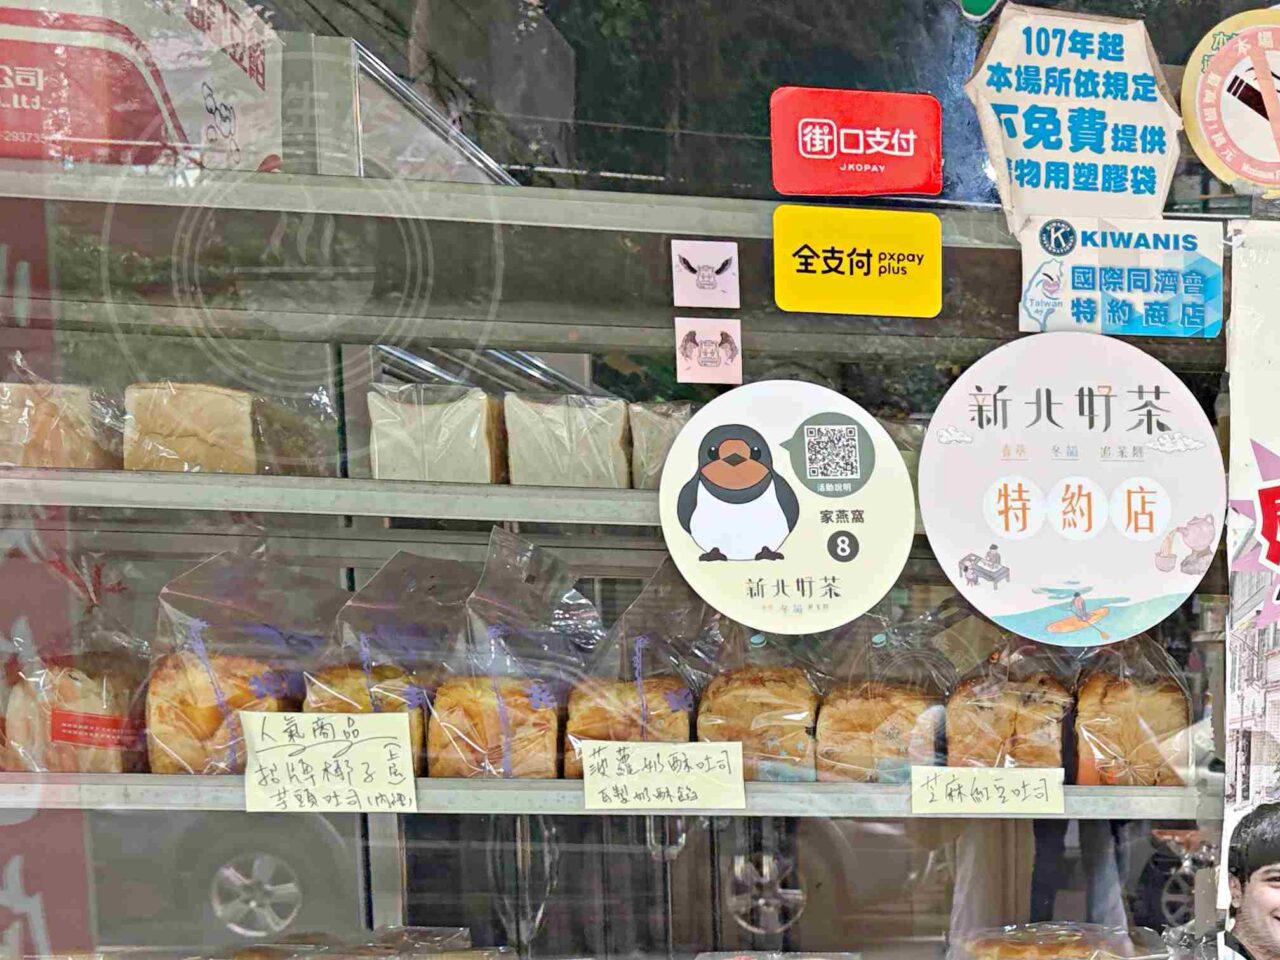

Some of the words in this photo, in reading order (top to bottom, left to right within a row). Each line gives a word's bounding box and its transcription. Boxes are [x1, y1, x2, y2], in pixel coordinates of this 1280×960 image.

[1022, 26, 1124, 62] 107年起
[986, 62, 1158, 102] 本場所依規定
[798, 118, 918, 159] 街口支付
[840, 163, 885, 172] JKOPAY
[1006, 157, 1157, 195] 物用塑膠袋
[1081, 230, 1198, 251] KIWANIS
[792, 243, 873, 276] 全支付
[878, 251, 924, 265] pxpay
[878, 263, 907, 276] plus
[1071, 266, 1204, 295] 國際同濟會
[1071, 298, 1205, 328] 特約商店
[820, 509, 864, 524] 家燕窩
[997, 482, 1157, 533] 特約店
[836, 536, 851, 556] 8
[261, 715, 360, 742] 人氣商品
[921, 773, 1049, 803] 芝麻紅豆吐司
